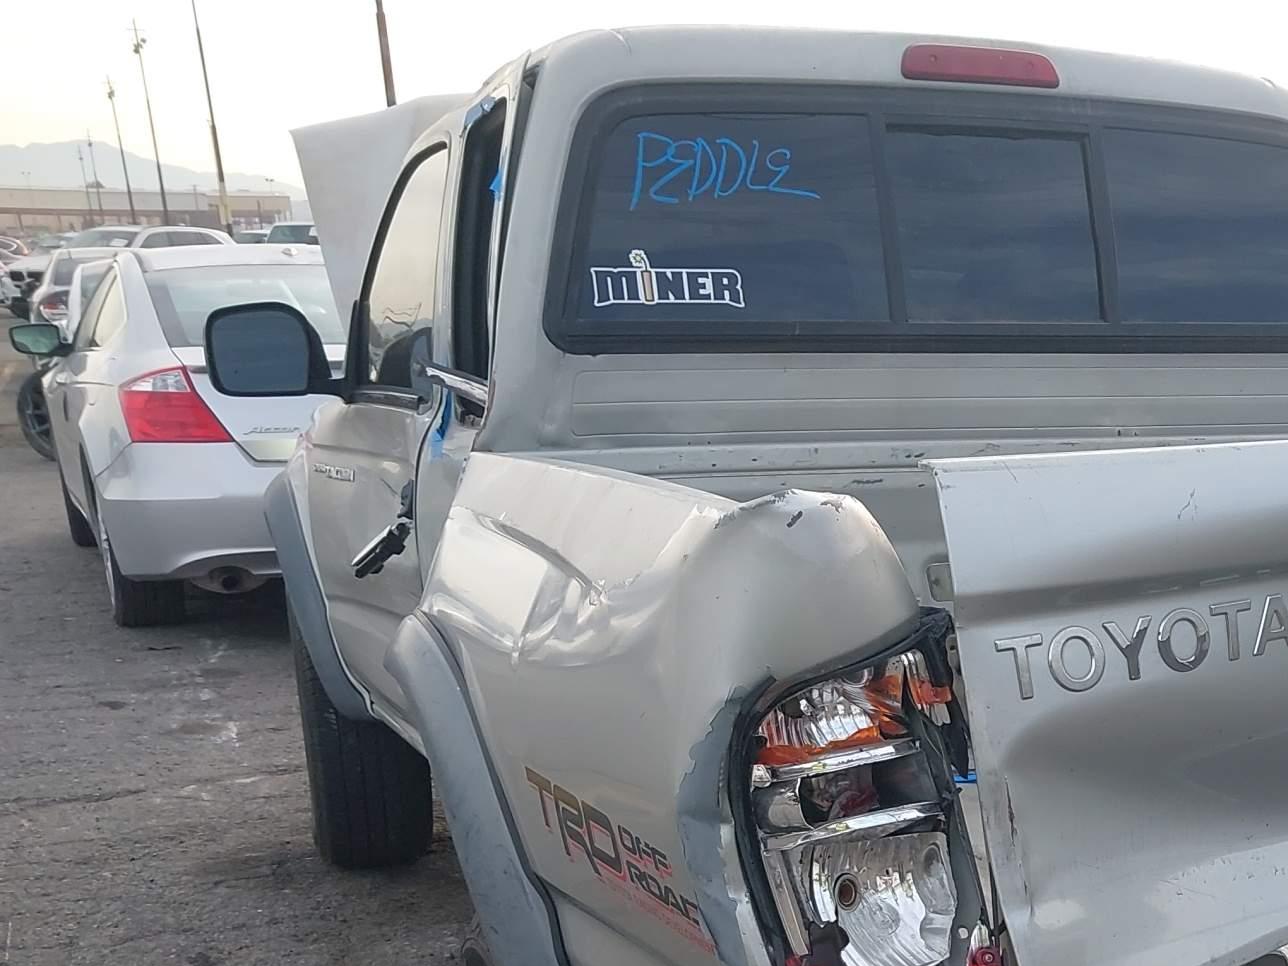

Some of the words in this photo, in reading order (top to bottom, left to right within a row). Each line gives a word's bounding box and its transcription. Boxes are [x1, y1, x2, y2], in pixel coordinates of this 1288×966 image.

[630, 131, 821, 211] PEDDLE
[590, 258, 746, 307] MINER
[525, 766, 624, 877] TRD
